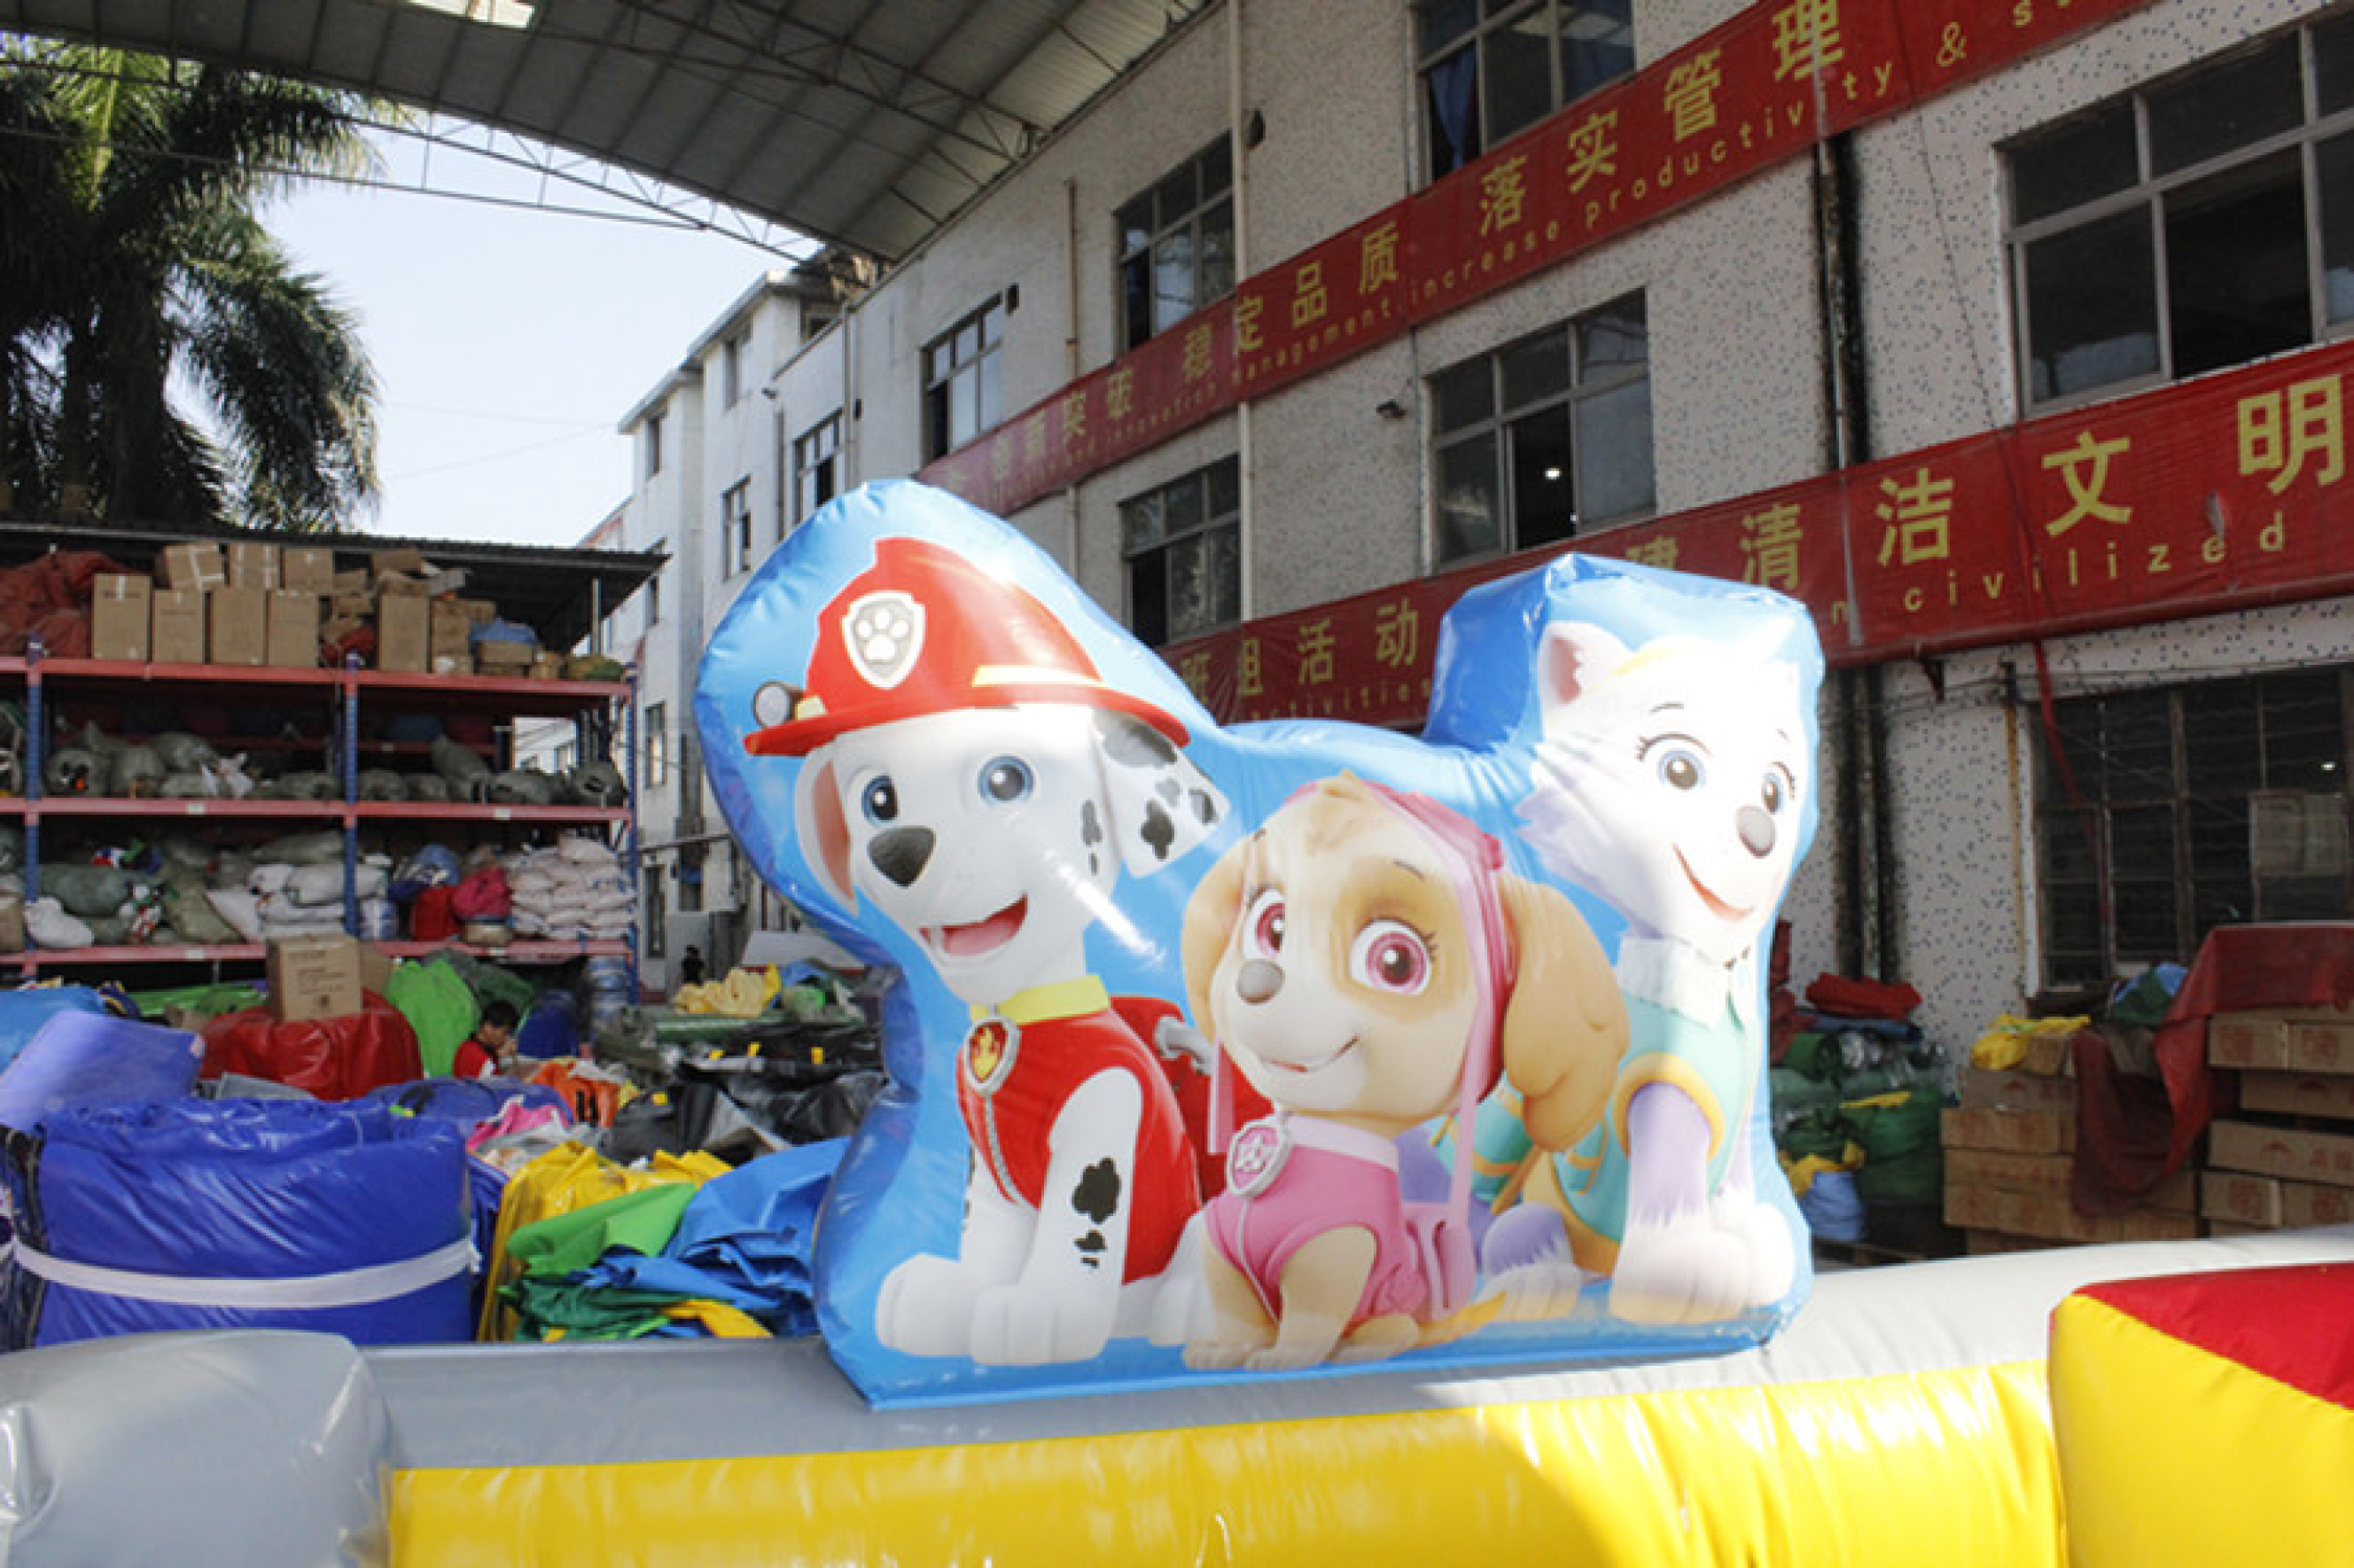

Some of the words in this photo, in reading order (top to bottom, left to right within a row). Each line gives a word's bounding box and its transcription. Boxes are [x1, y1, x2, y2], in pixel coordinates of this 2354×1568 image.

[1231, 295, 1393, 383] management
[1411, 223, 1561, 306] increase
[1585, 60, 1893, 229] productivity
[1937, 21, 1969, 67] &
[1480, 0, 1843, 236] 落实管理
[1904, 512, 2285, 612] civilized
